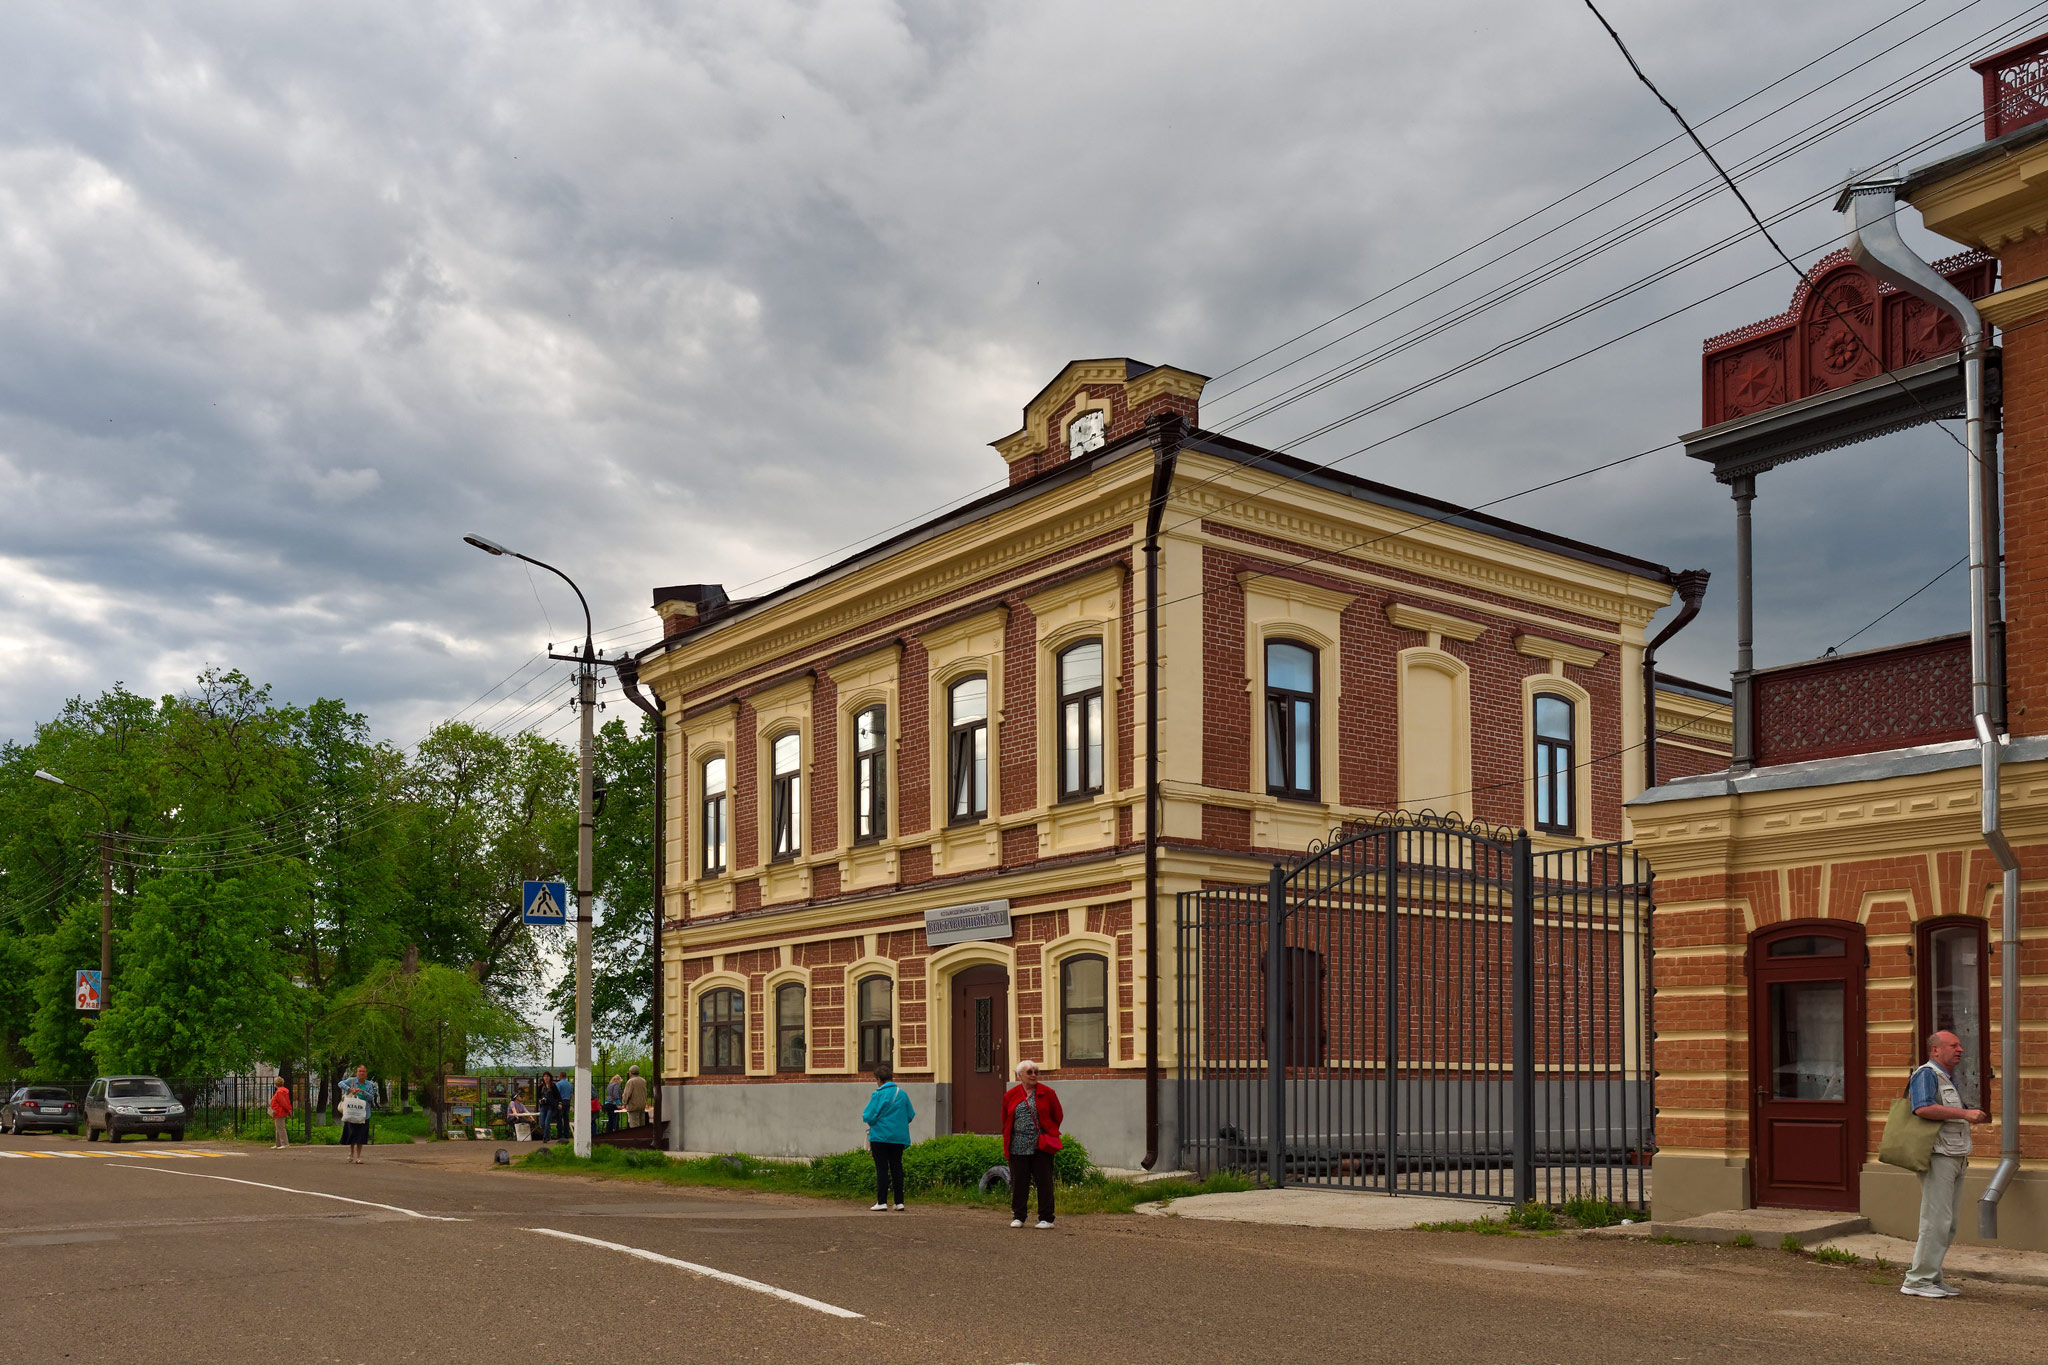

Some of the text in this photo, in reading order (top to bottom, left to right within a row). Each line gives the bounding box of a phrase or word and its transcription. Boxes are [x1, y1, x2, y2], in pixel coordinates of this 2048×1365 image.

[928, 911, 1004, 933] ВЫСТАВОЧНЫЙ ЗАЛ
[78, 993, 86, 1008] 9
